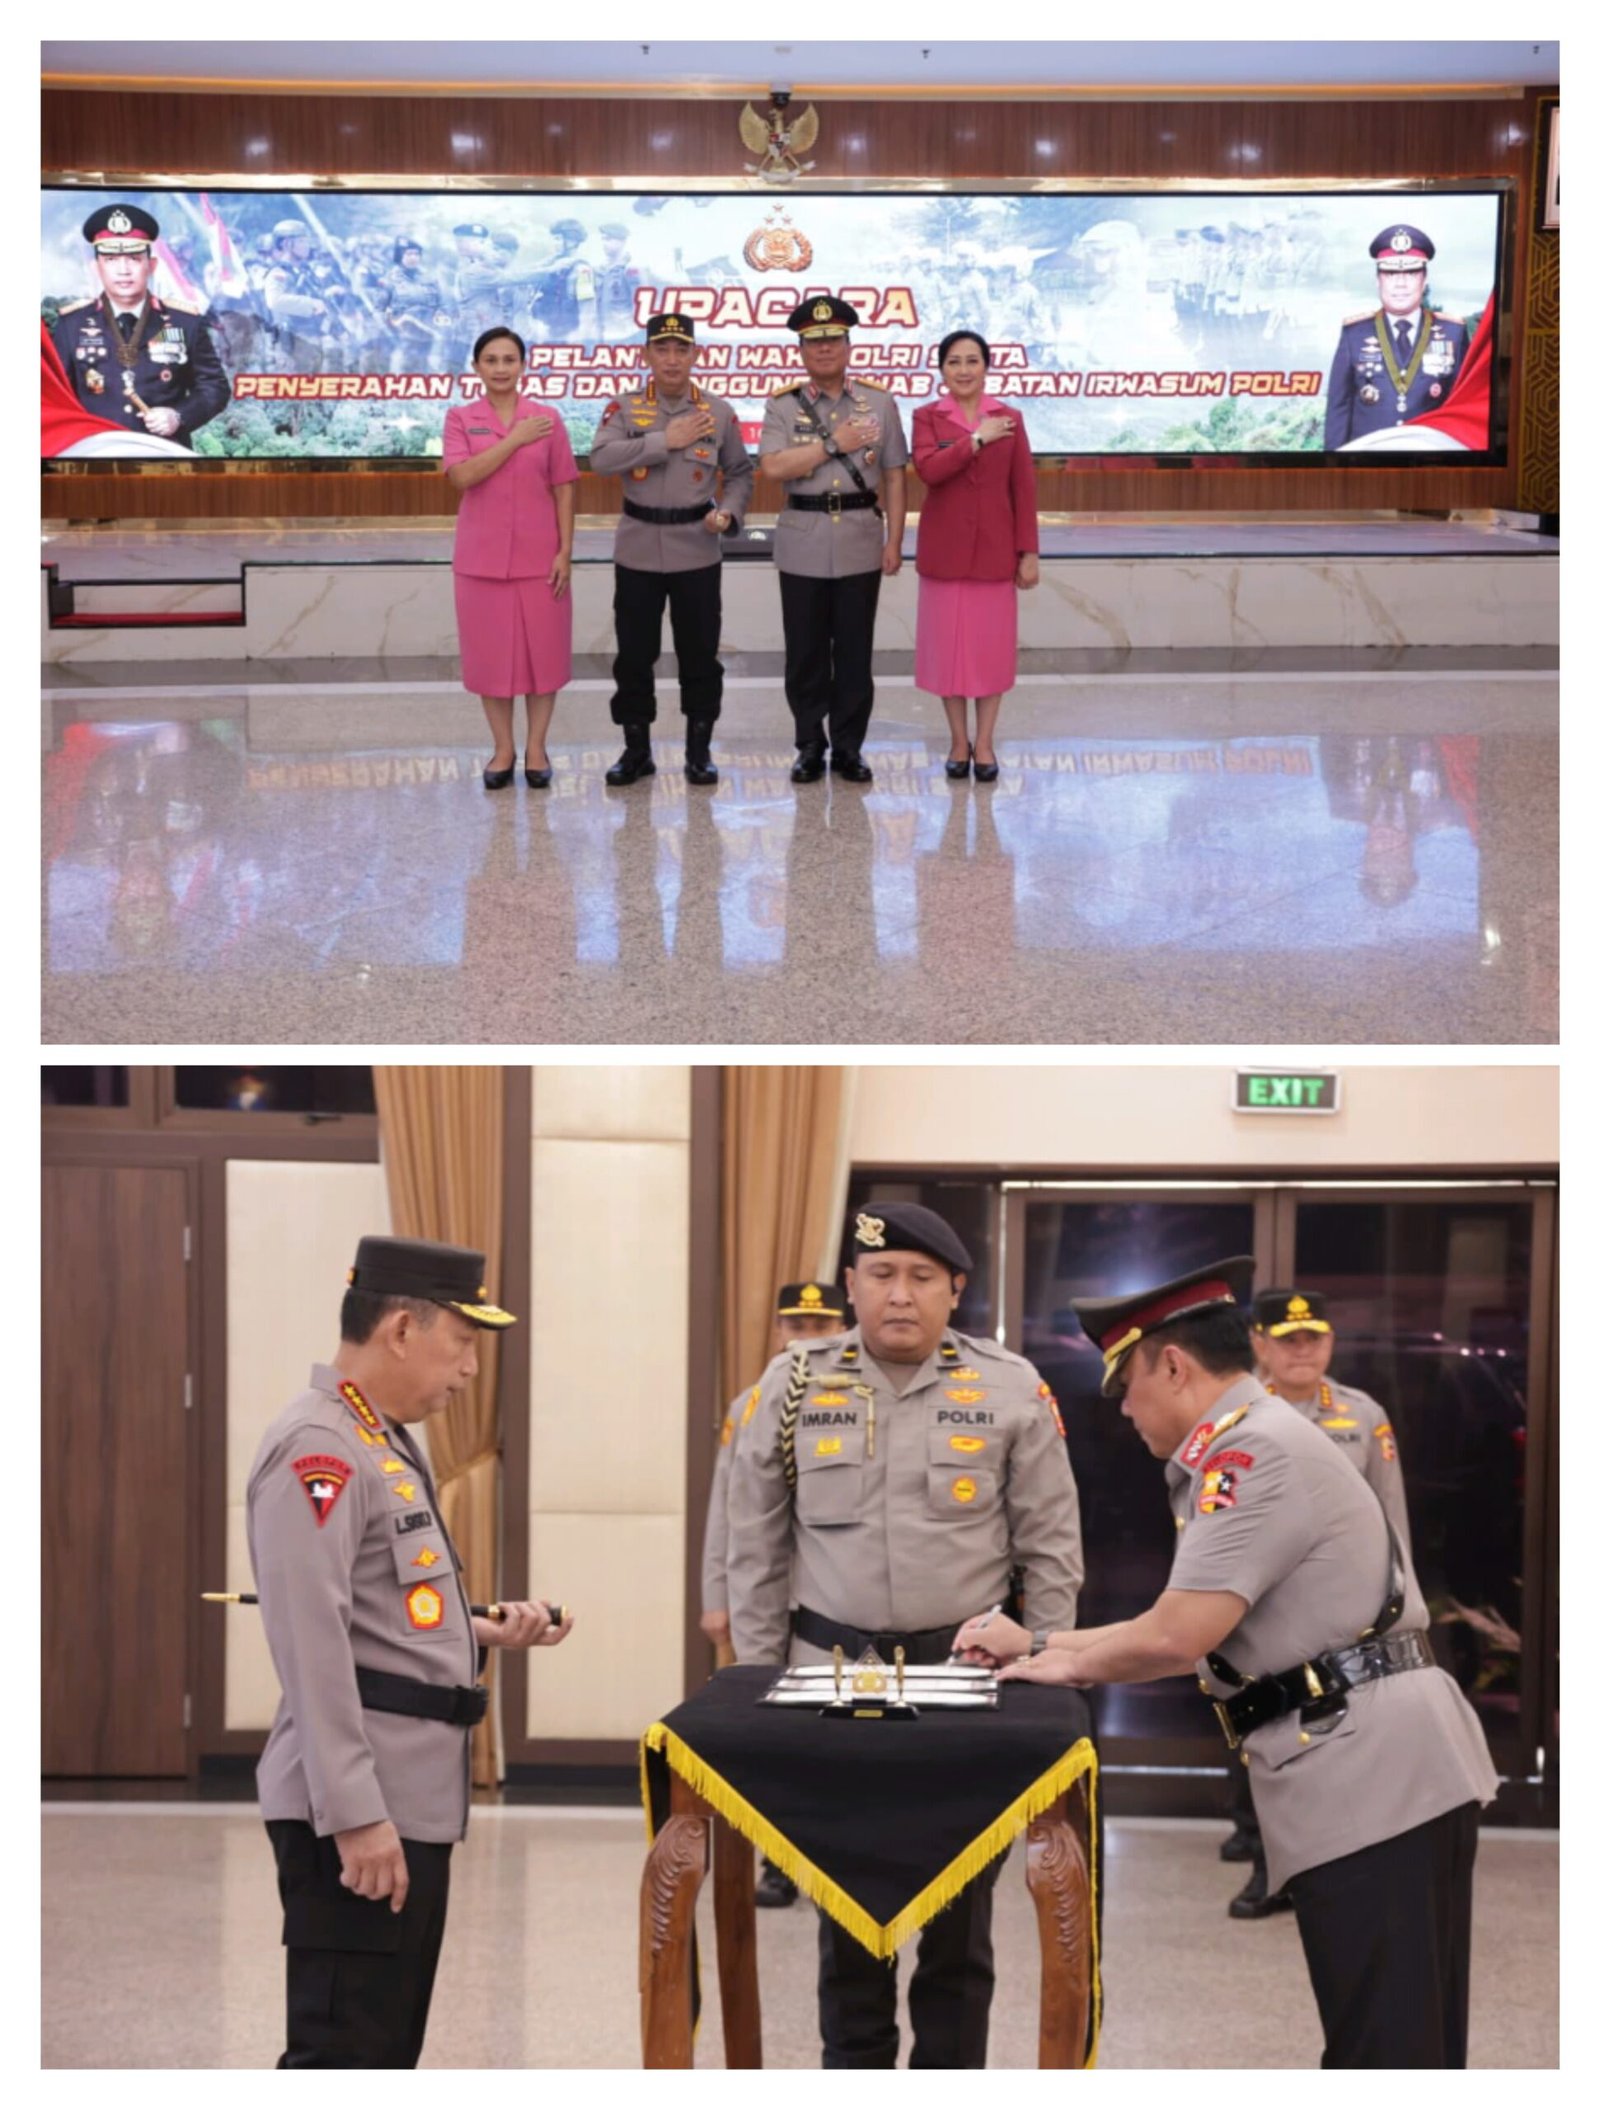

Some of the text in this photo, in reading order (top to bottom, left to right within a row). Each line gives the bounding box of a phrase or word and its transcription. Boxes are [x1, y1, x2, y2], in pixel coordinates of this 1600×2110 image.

[635, 287, 919, 328] UPACRA
[235, 374, 452, 399] PENYERAHAN
[574, 374, 642, 398] DAN
[938, 373, 1079, 397] BATAN
[1085, 372, 1225, 397] IRWASUM
[1231, 372, 1323, 396] POLRI
[1249, 1078, 1325, 1106] EXIT
[802, 1412, 857, 1427] IMRAN
[937, 1411, 994, 1425] POLRI
